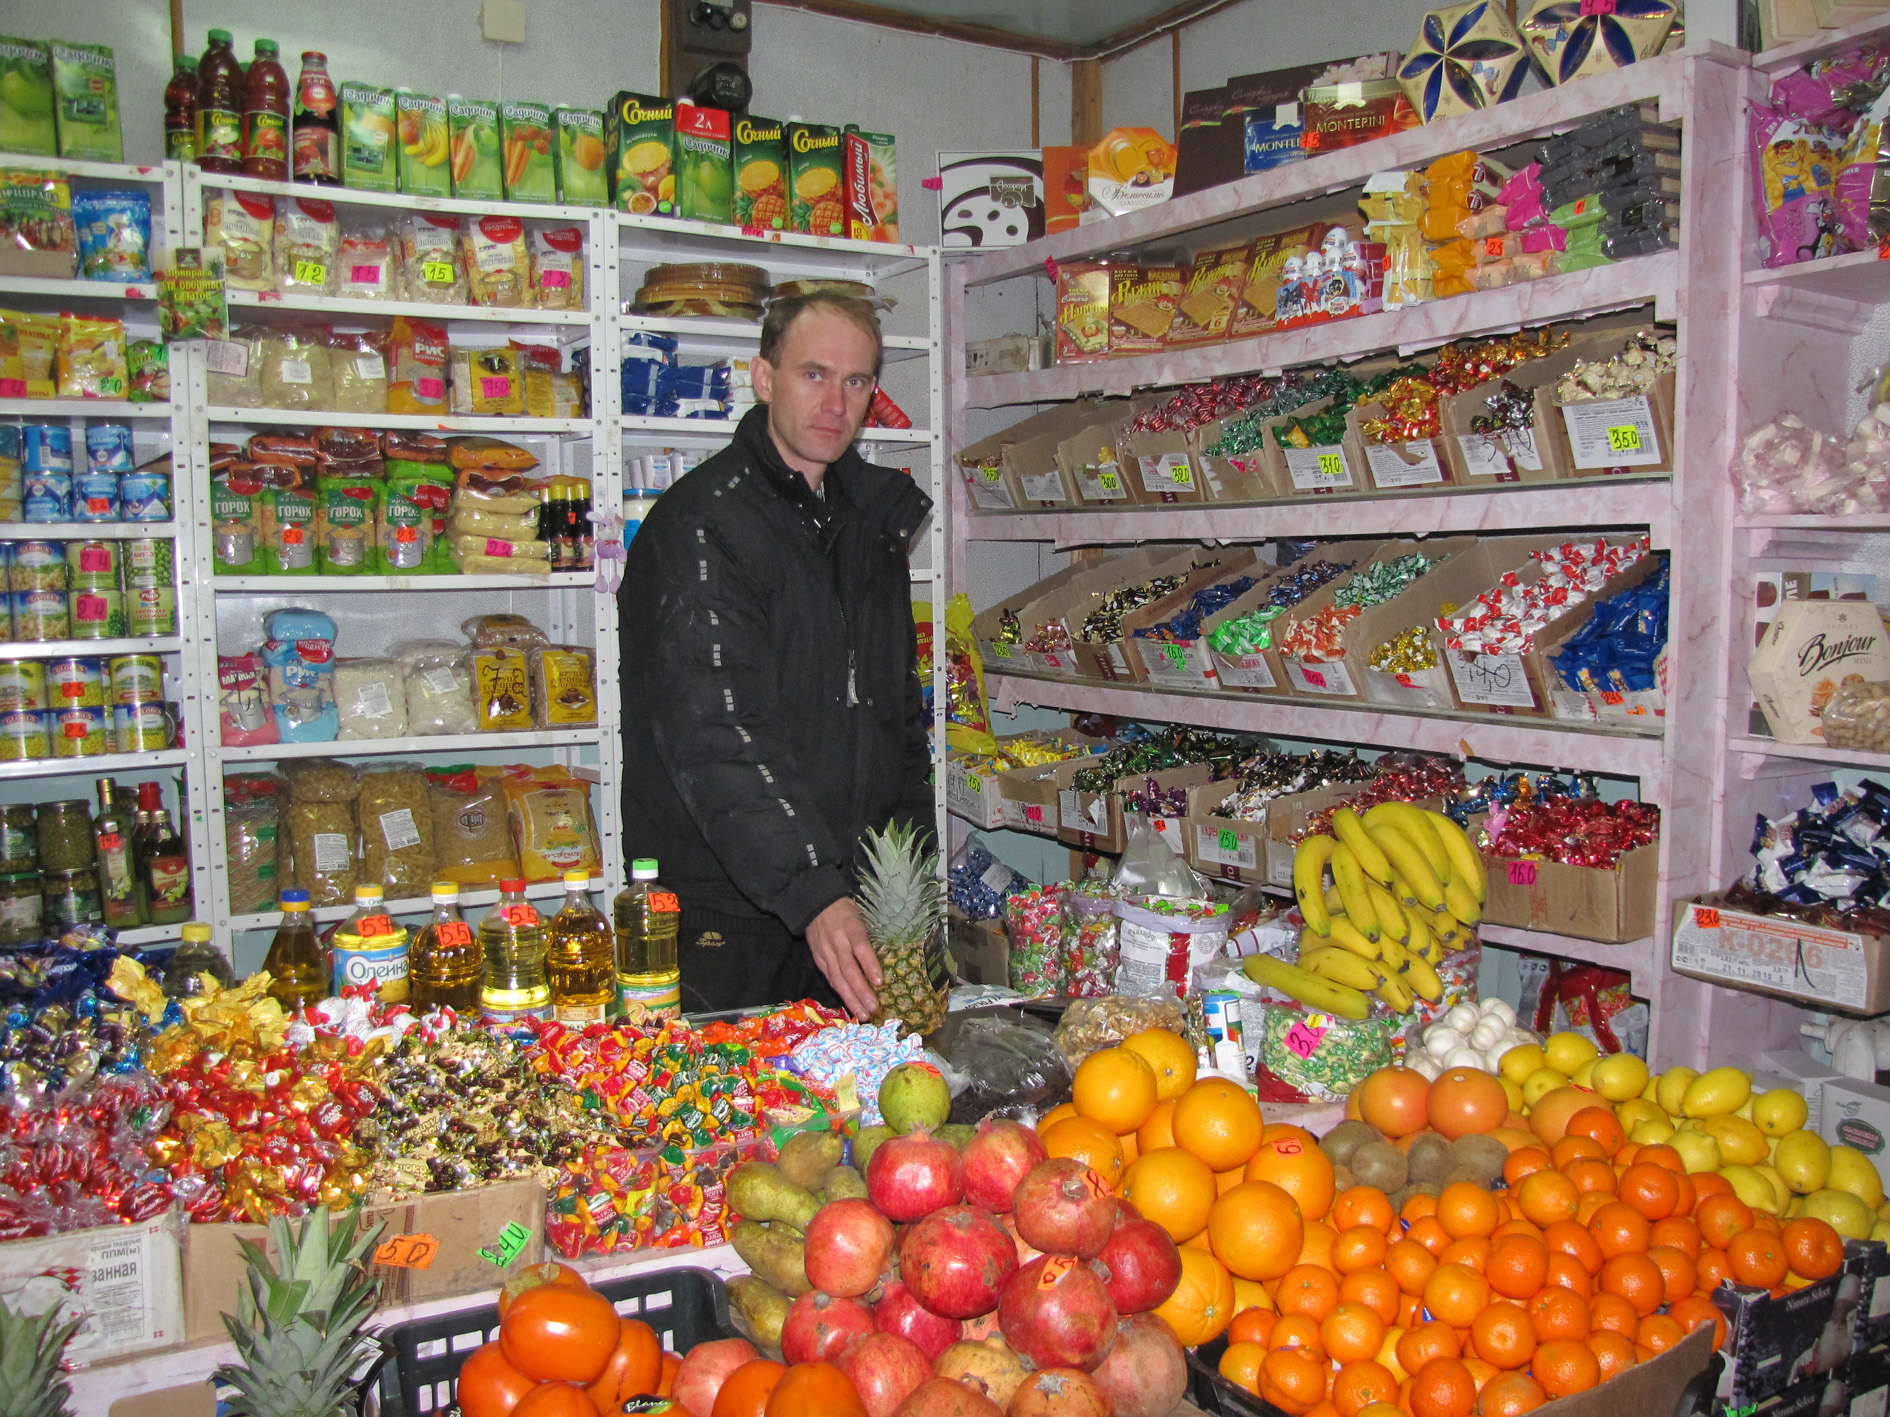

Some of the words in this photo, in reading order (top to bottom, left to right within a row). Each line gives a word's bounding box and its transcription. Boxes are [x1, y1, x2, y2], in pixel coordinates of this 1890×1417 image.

[344, 89, 393, 107] Садочок
[399, 96, 446, 115] Садочок
[450, 103, 495, 120] Садочок
[504, 107, 549, 124] Садочок
[559, 111, 602, 130] Садочок
[622, 100, 673, 125] Сочный
[736, 121, 781, 145] Сочный
[793, 128, 839, 153] Сочный
[683, 137, 730, 159] Садочок
[856, 142, 873, 228] Любимый
[1119, 199, 1150, 207] CLASSICO
[1612, 430, 1638, 449] 350
[1172, 466, 1190, 482] 320
[215, 501, 251, 514] ГОРОХ
[278, 505, 312, 518] ГОРОХ
[330, 506, 364, 519] ГОРОХ
[1797, 632, 1877, 677] Bonjour
[1219, 831, 1239, 848] 150
[321, 1103, 343, 1125] GRAND
[327, 1111, 344, 1126] PRIX
